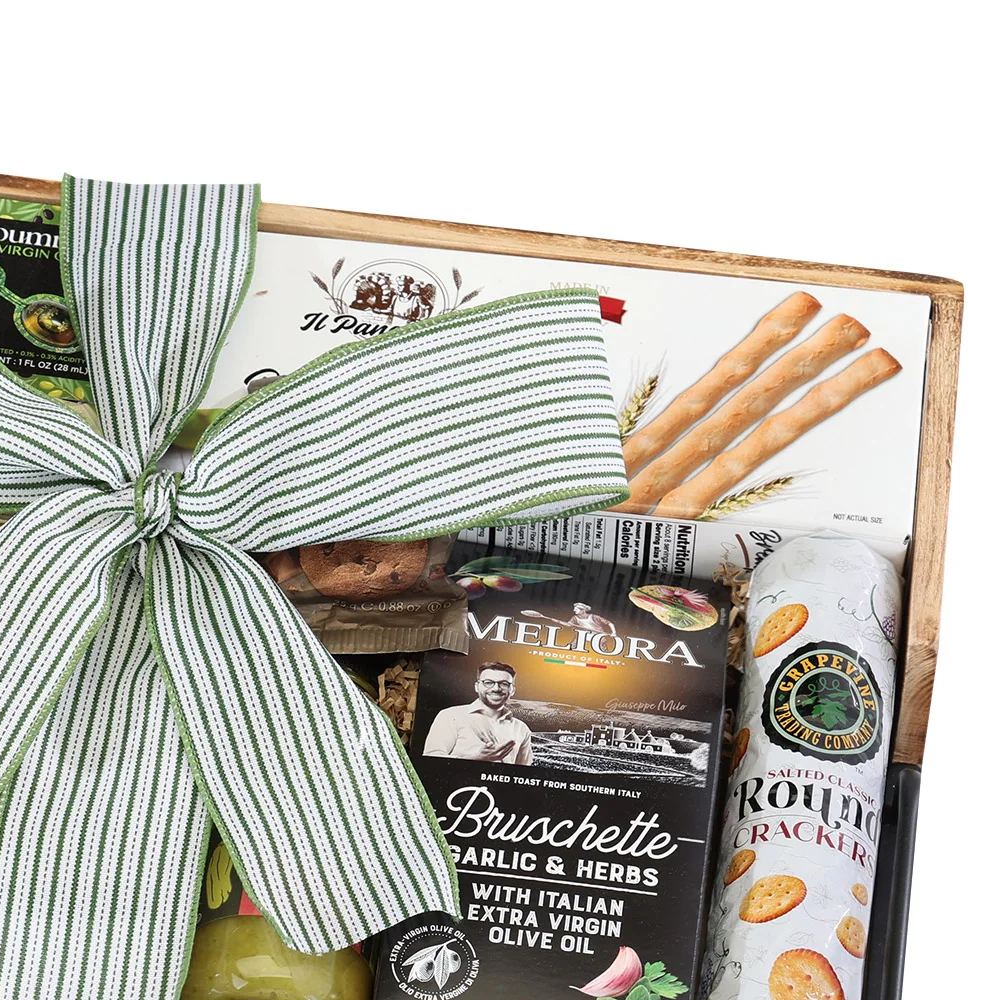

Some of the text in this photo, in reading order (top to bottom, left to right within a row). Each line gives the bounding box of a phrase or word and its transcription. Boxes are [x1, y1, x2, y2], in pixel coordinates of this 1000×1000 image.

[833, 513, 883, 524] NOT ACTUAL SIZE
[619, 520, 634, 559] Calories
[674, 524, 692, 575] Nutrition
[468, 612, 704, 668] MELIORA
[779, 653, 876, 713] GRAPEVINE
[605, 698, 688, 712] Giuseppe Milo
[774, 702, 875, 751] TRADING COMPANY
[480, 773, 642, 799] BAKED TOAST FROM SOUTHERN ITALY
[767, 767, 824, 781] SALTED
[440, 786, 678, 860] Bruschette
[447, 845, 660, 888] GARLIC & HERBS
[734, 821, 875, 878] CRACKERS
[471, 882, 624, 917] WITH ITALIAN
[467, 904, 622, 938] EXTRA VIRGIN
[489, 926, 595, 955] OLIVE OIL
